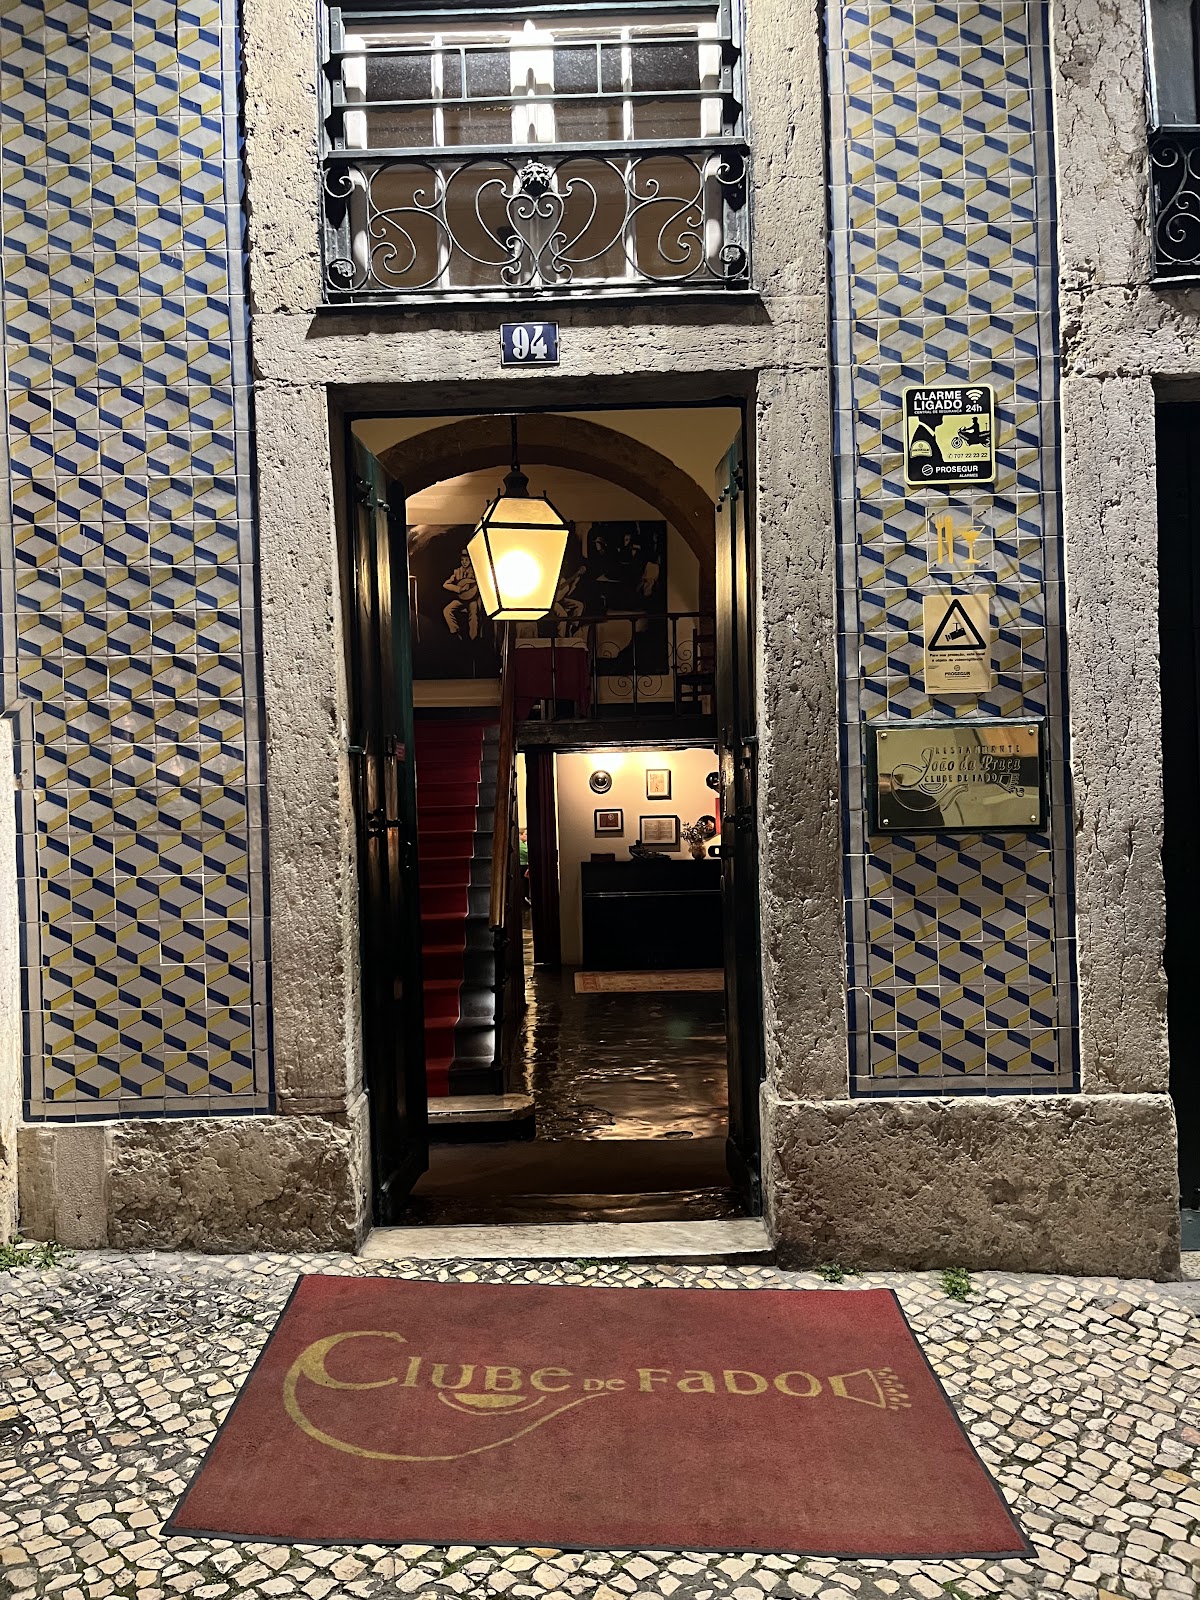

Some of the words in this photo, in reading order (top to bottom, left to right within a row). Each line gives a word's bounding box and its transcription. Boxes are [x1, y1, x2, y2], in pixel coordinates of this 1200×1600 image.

[512, 325, 548, 360] 94
[914, 390, 962, 400] ALARME
[914, 399, 963, 411] LIGADO
[965, 403, 983, 413] 24h
[935, 465, 979, 473] PROSEGUR
[935, 745, 1020, 754] RESTAURANTE
[959, 755, 977, 771] da
[980, 754, 1021, 773] Praça
[924, 774, 953, 783] CLUBE
[957, 774, 968, 782] DE
